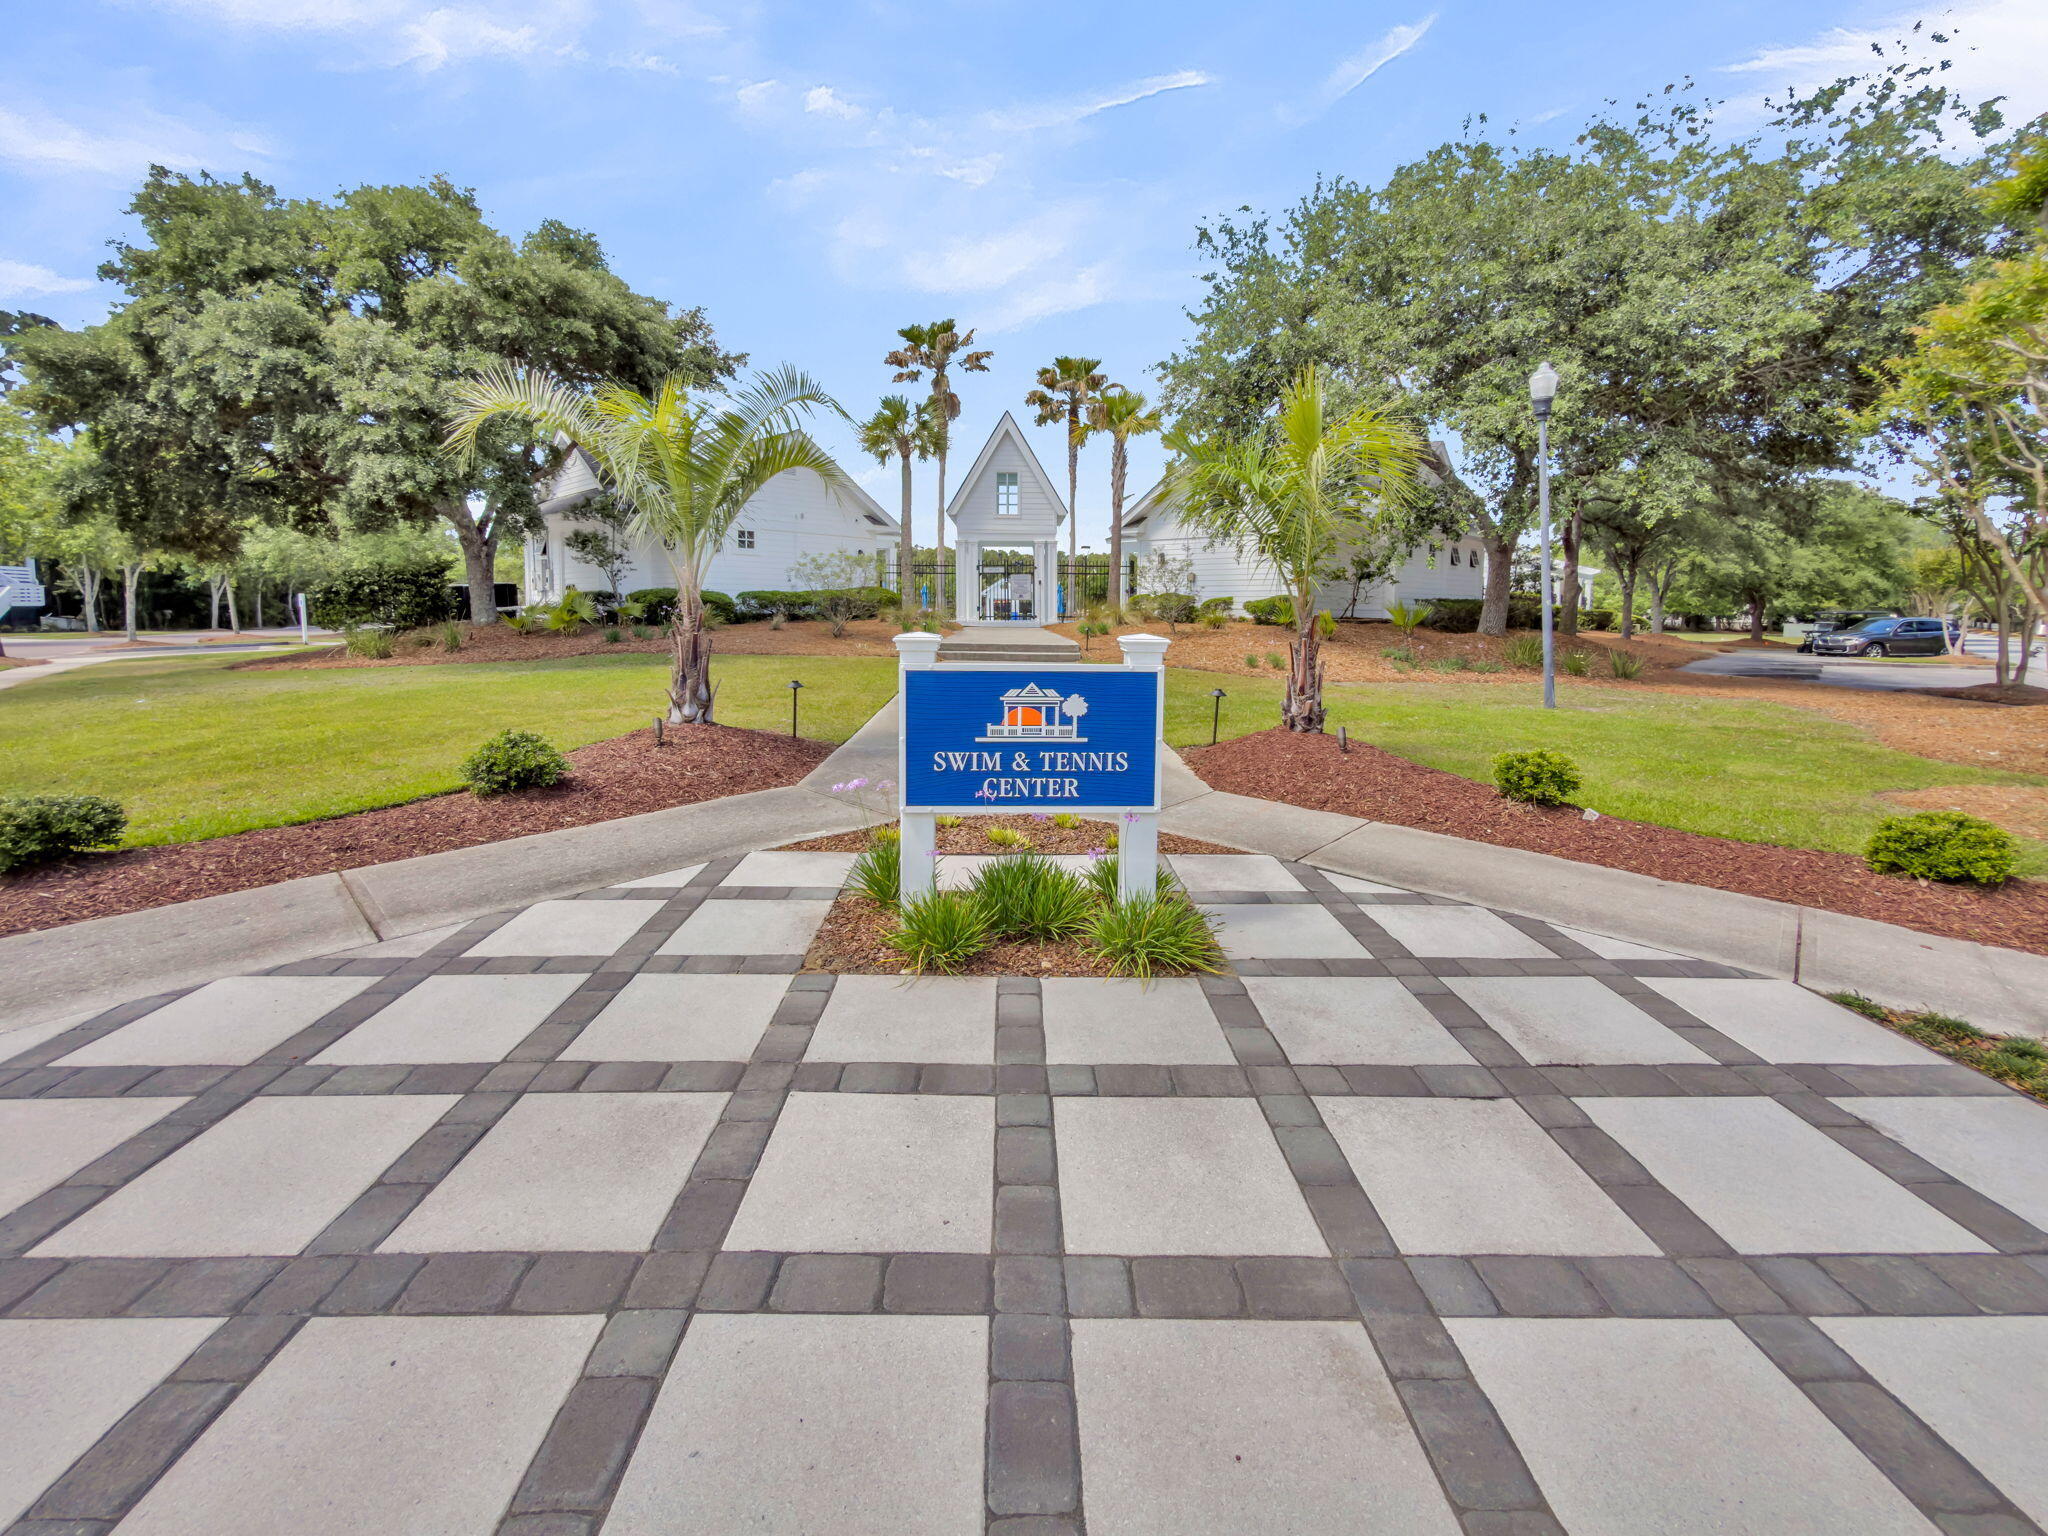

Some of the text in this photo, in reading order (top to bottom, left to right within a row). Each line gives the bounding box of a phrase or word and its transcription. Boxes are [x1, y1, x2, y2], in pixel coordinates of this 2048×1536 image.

[933, 751, 1128, 772] SWIM & TENNIS
[982, 777, 1080, 798] CENTER
